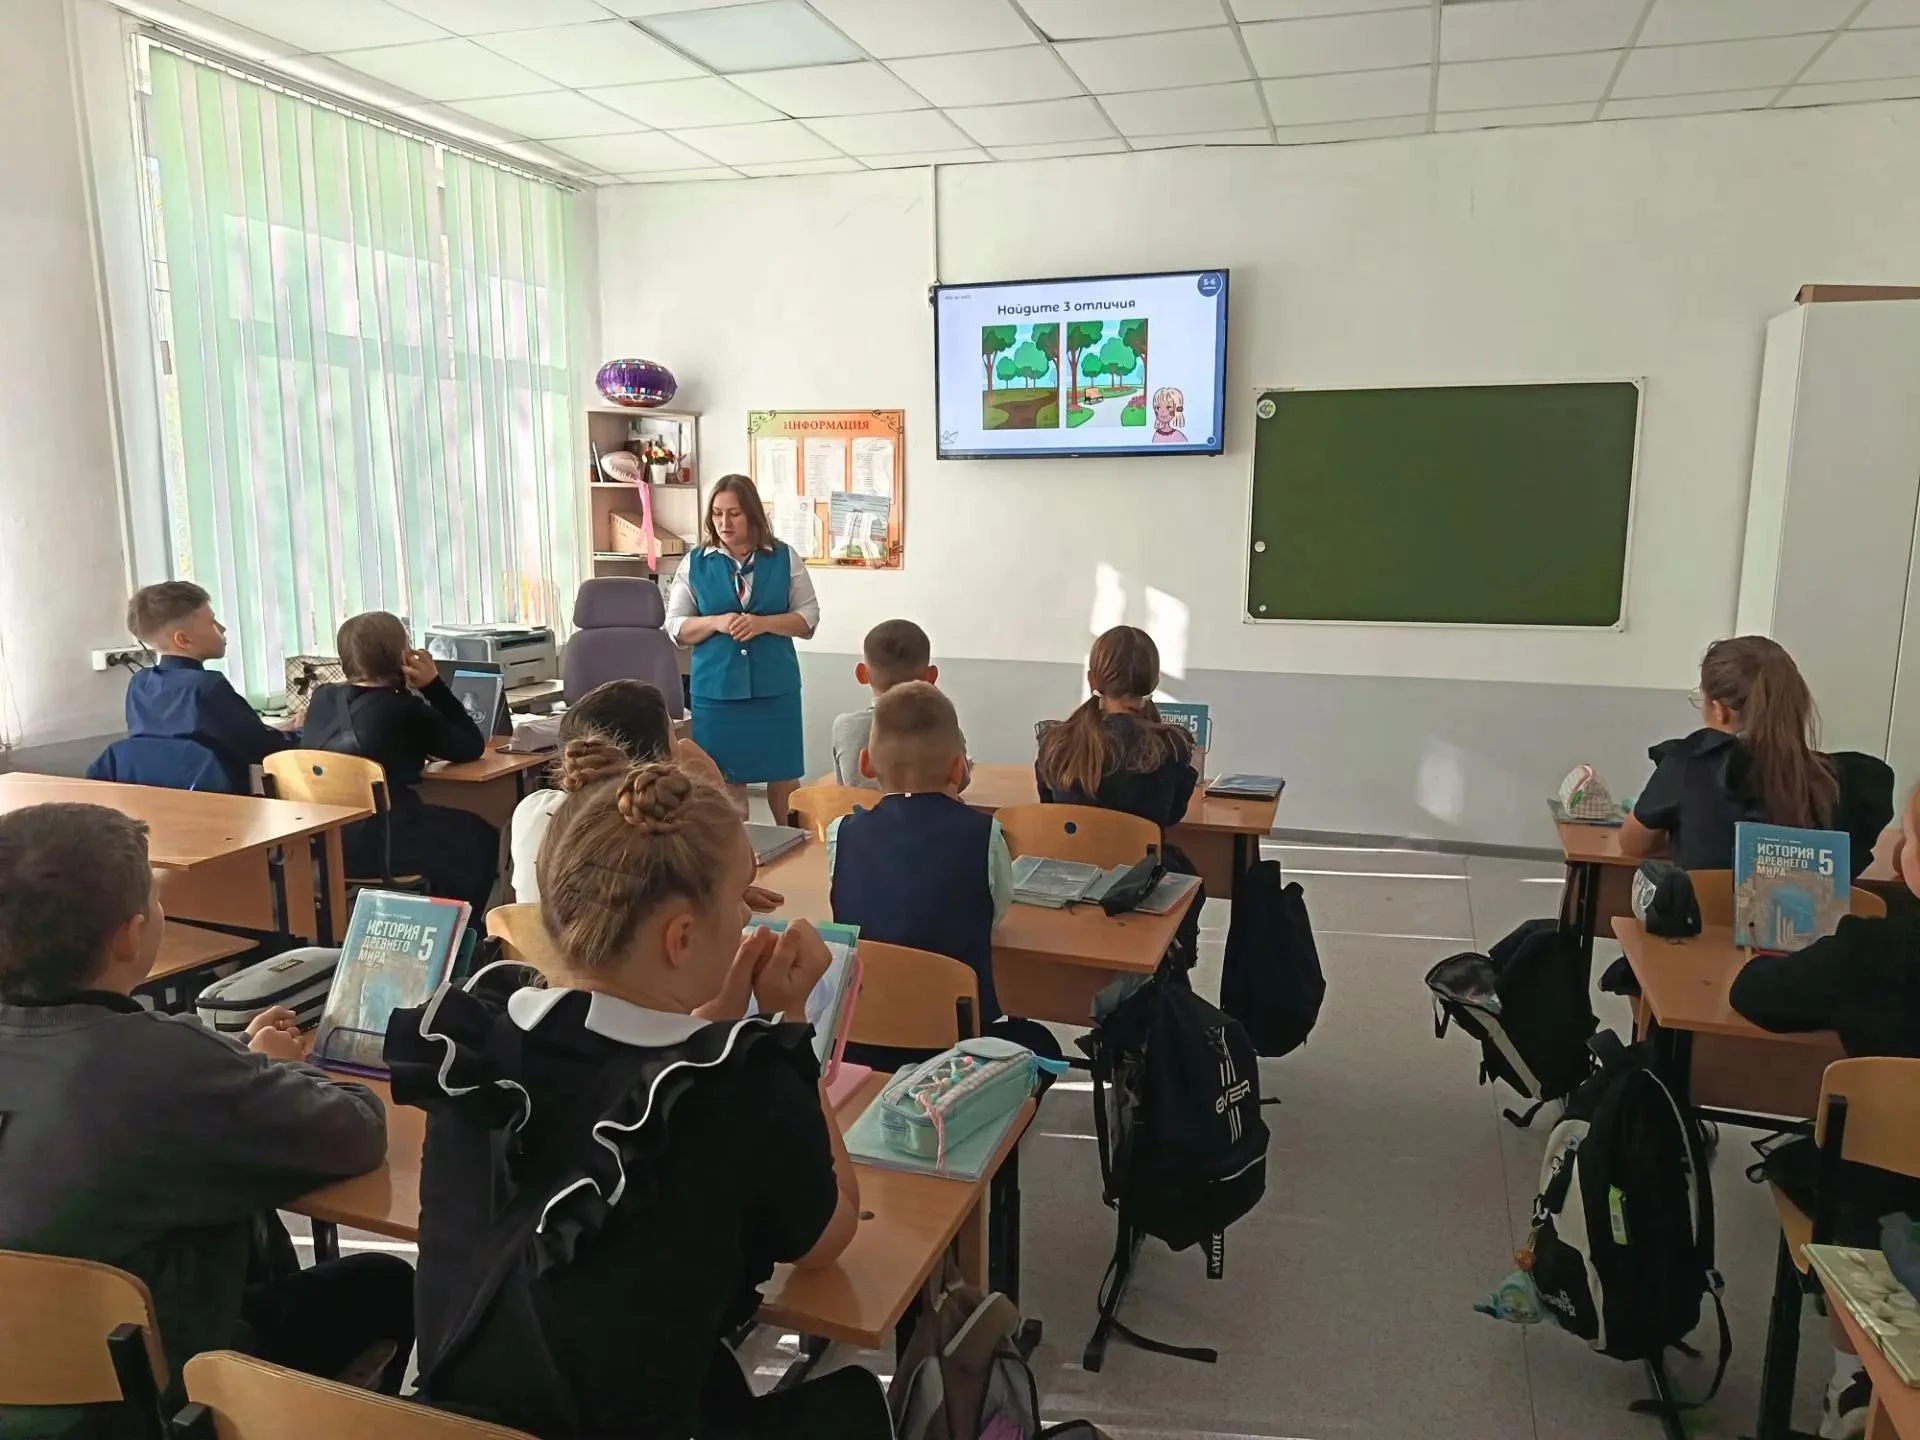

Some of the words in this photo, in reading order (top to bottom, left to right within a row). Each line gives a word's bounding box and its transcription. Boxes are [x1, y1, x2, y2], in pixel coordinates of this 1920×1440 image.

[997, 304, 1060, 317] Найдите
[1063, 301, 1071, 312] 3
[1074, 299, 1136, 311] отличия
[783, 420, 870, 432] ИНФОРМАЦИЯ
[1160, 713, 1188, 723] СТОРИЯ
[1189, 715, 1198, 732] 5
[1757, 843, 1815, 860] ИСТОРИЯ
[1756, 855, 1808, 869] ДРЕВНЕГО
[1818, 848, 1834, 876] 5
[1756, 865, 1786, 877] МИРА
[366, 920, 421, 941] ИСТОРИЯ
[361, 935, 411, 953] ДРЕВНЕГО
[417, 926, 438, 962] 5
[357, 949, 386, 965] МИРА
